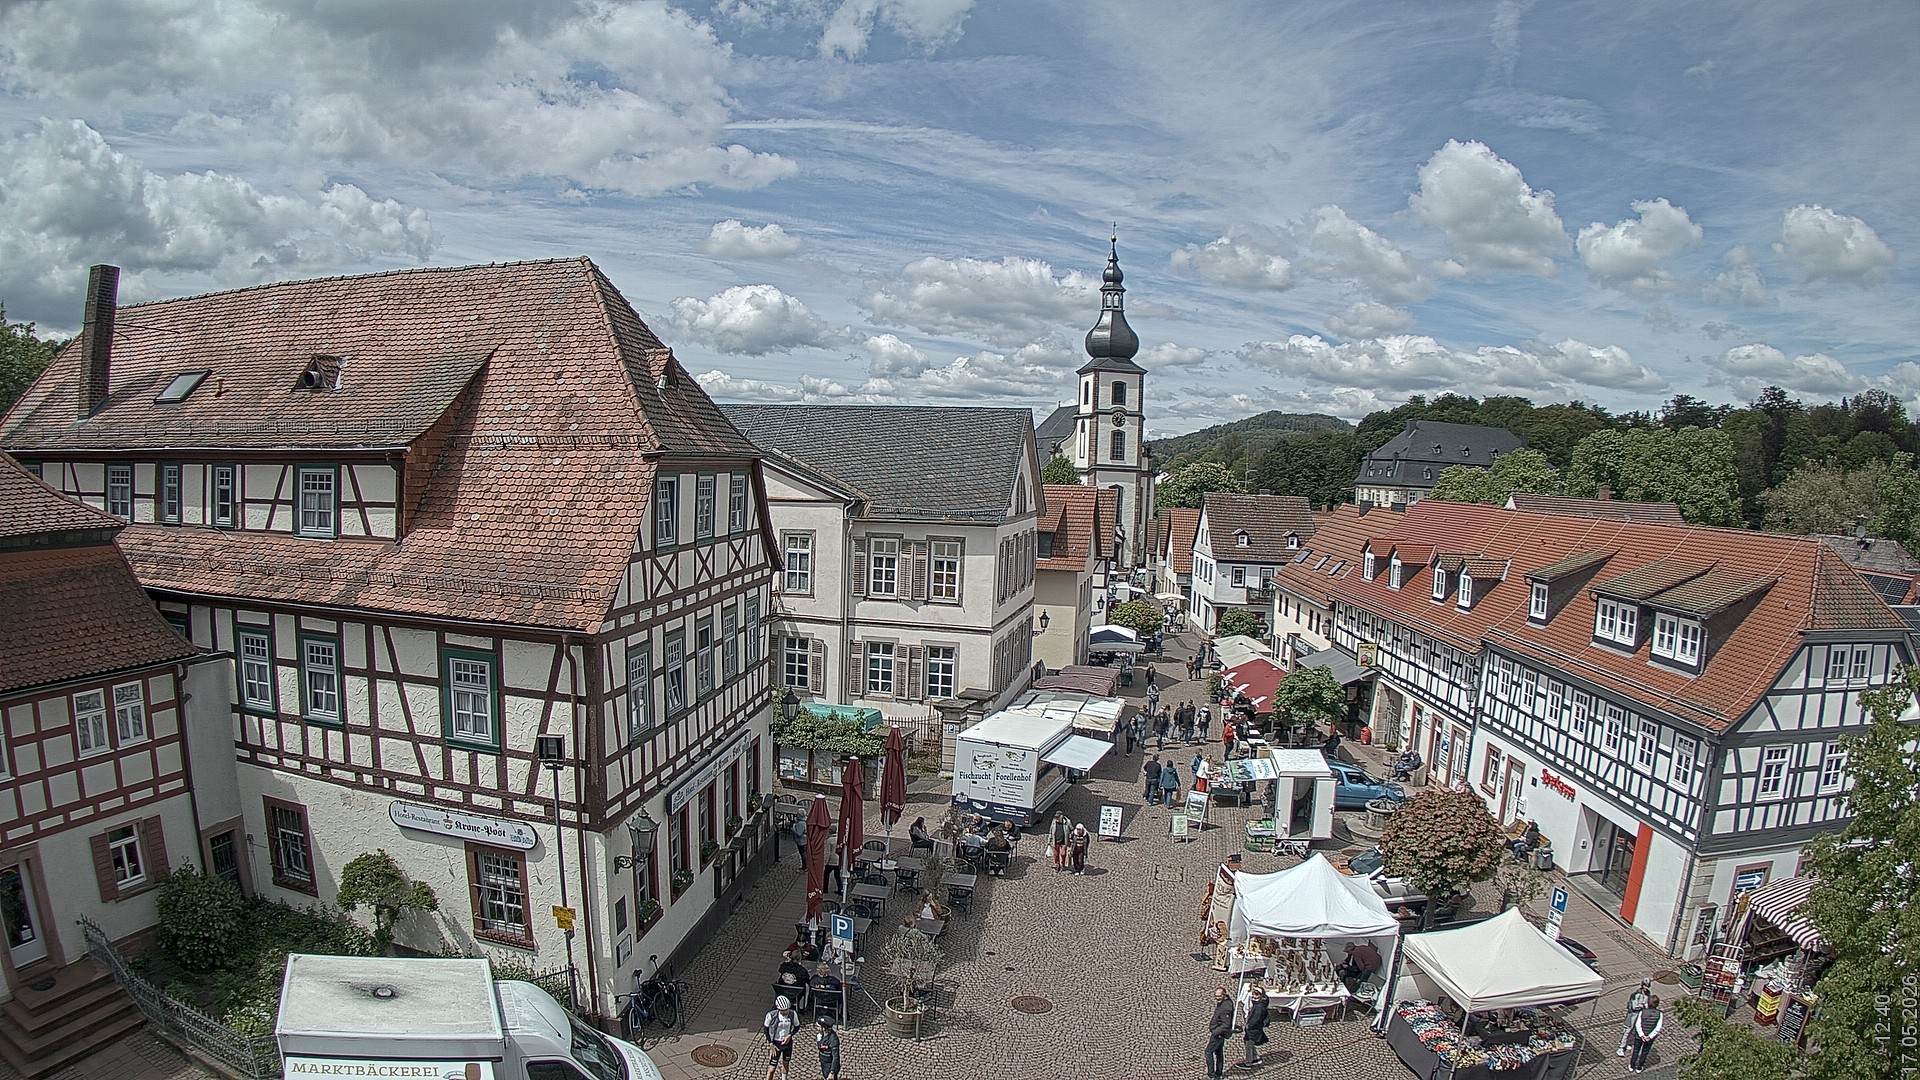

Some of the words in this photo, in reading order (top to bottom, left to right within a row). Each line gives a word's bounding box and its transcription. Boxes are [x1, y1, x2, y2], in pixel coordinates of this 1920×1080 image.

[959, 771, 992, 780] Fischzucht
[996, 772, 1032, 782] Forellenhof
[394, 810, 441, 826] Hotel-Restaurant
[455, 820, 507, 838] Krone-Post
[1553, 890, 1565, 907] P
[837, 919, 848, 935] P
[291, 1062, 440, 1077] MARKTBÄCKEREI
